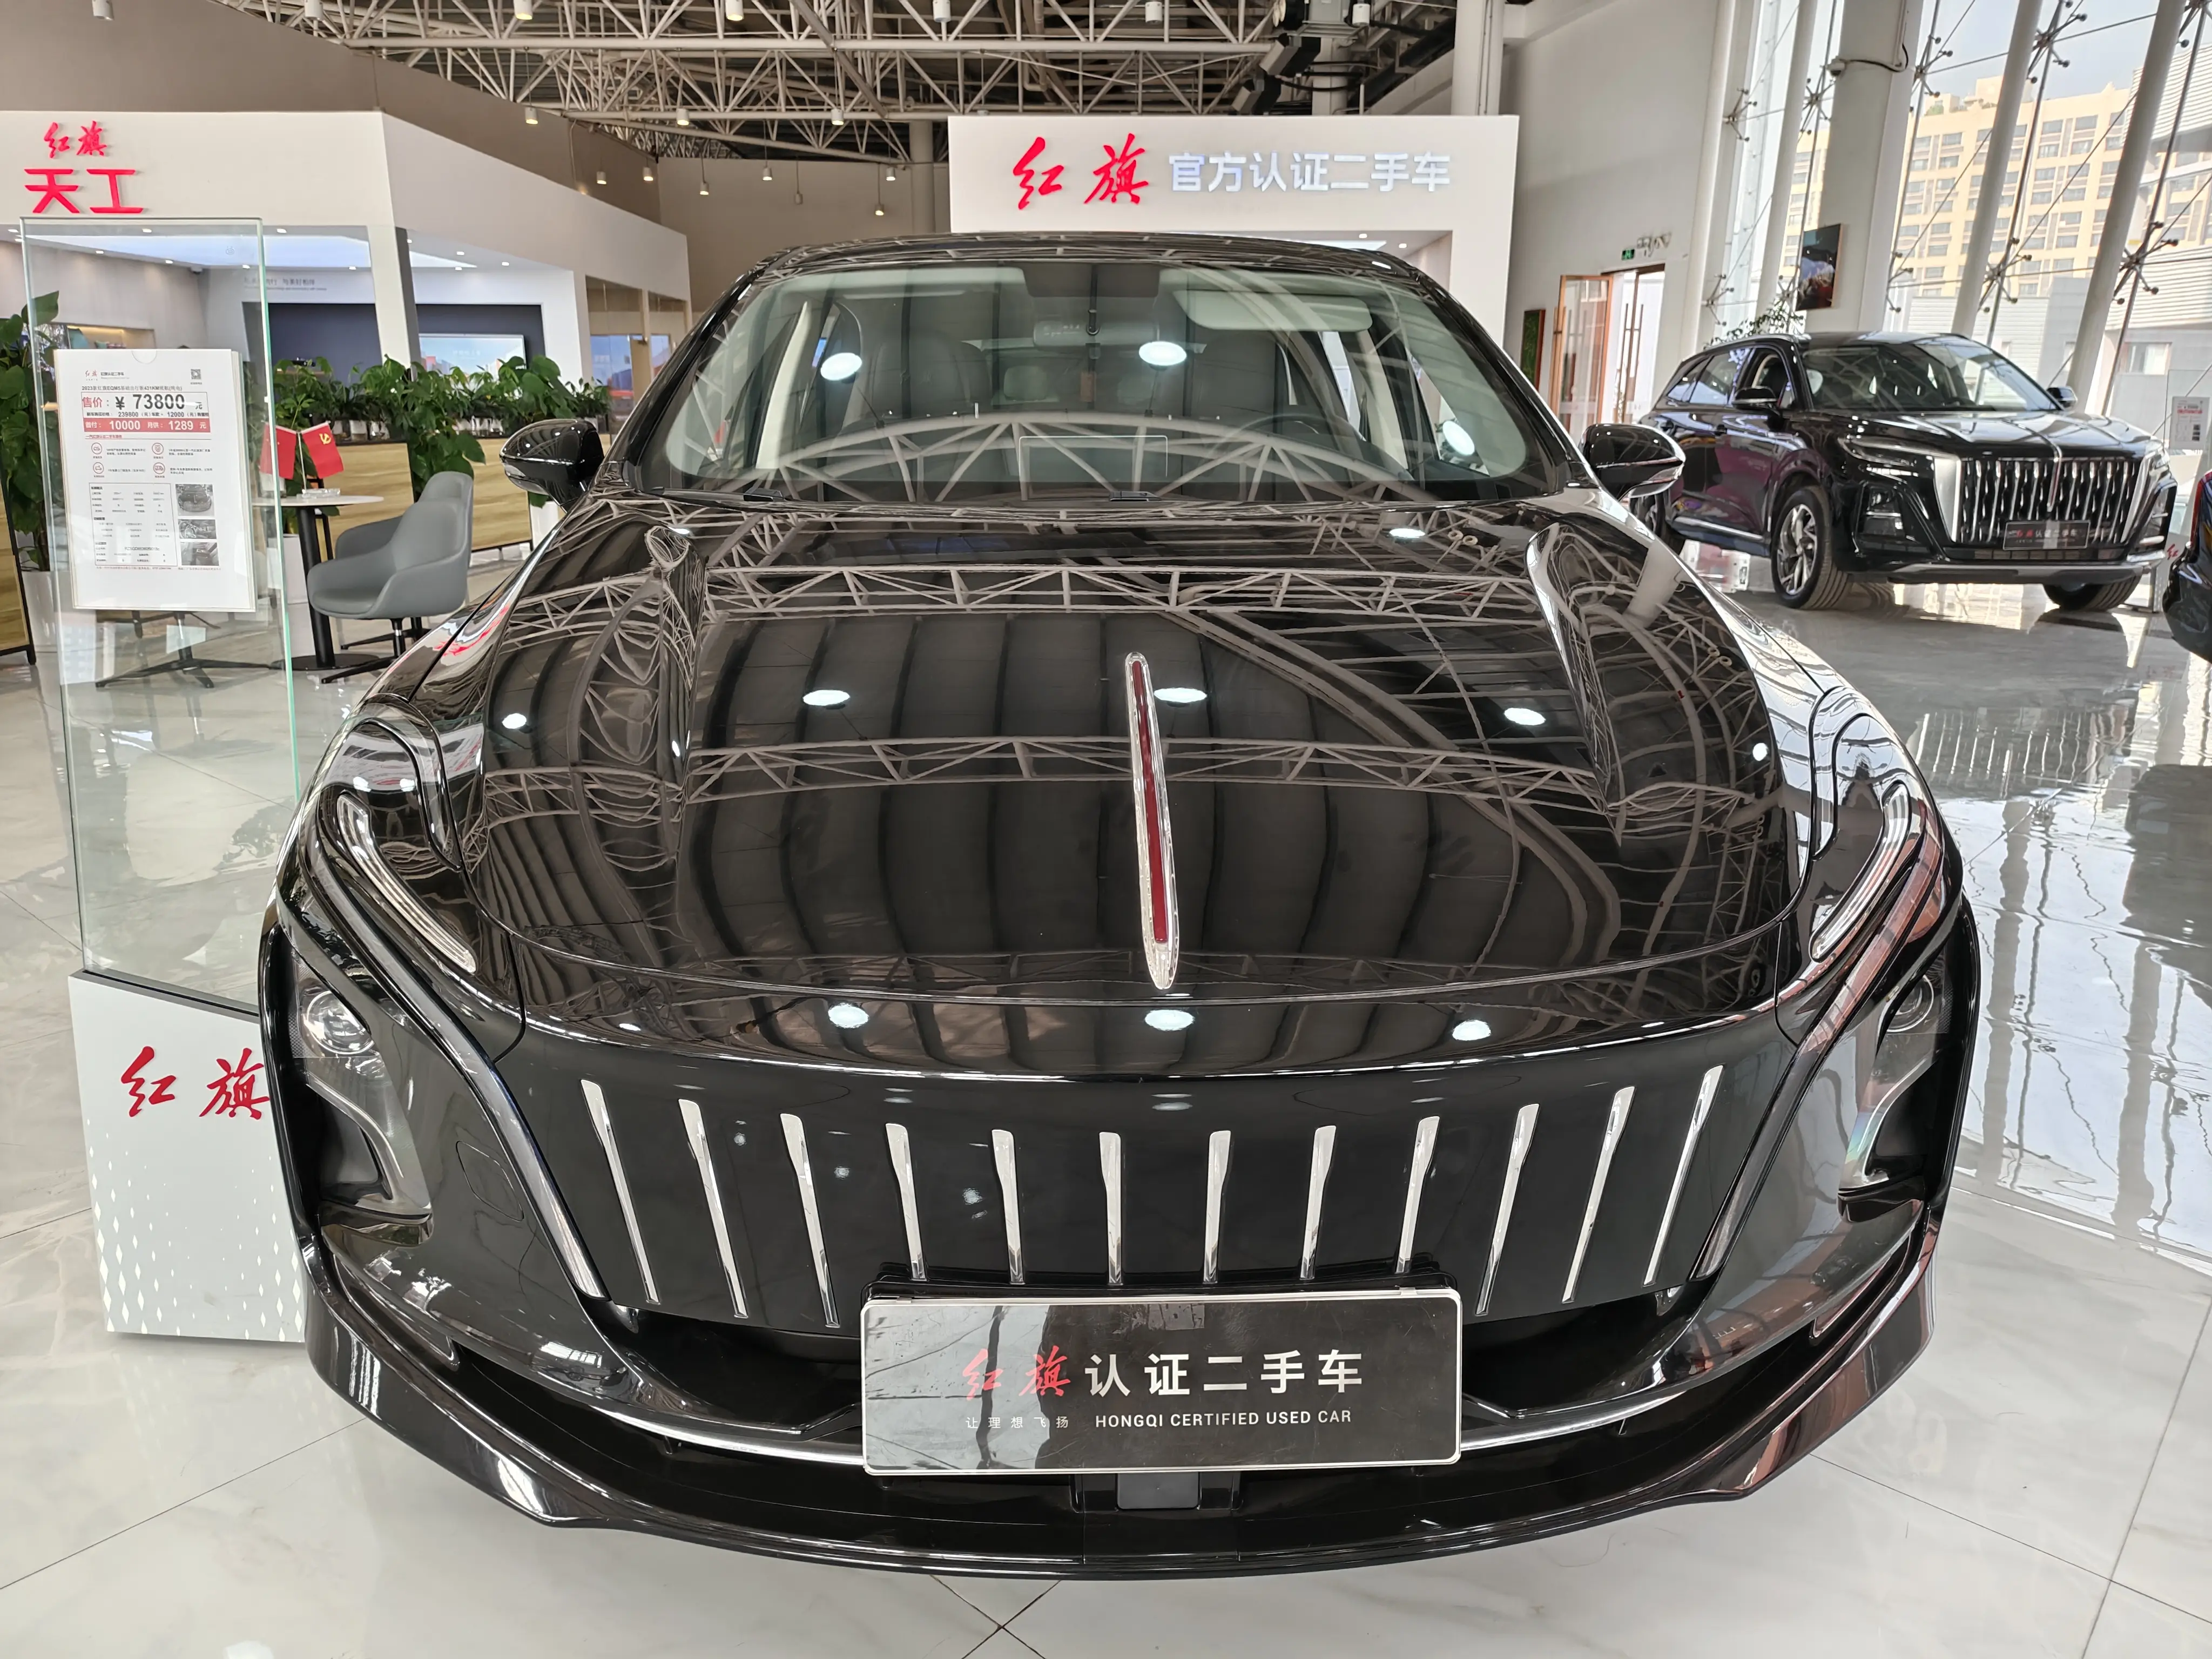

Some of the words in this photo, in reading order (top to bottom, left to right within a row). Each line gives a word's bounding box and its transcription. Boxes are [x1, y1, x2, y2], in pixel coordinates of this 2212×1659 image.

[44, 120, 107, 158] 红旗
[1013, 133, 1149, 210] 红旗
[1169, 150, 1451, 192] 官方认证二手车
[24, 169, 143, 213] 天工
[133, 394, 185, 409] 73800
[109, 421, 140, 430] 10000
[168, 421, 194, 430] 1289
[121, 1047, 269, 1120] 红旗
[962, 1345, 1071, 1400] 红旗
[1084, 1349, 1362, 1397] 认证二手车
[966, 1416, 1068, 1429] 让理想飞扬
[1096, 1414, 1163, 1428] HONGQI
[1170, 1412, 1259, 1427] CERTIFIED
[1266, 1411, 1311, 1425] USED
[1318, 1410, 1351, 1423] CAR
